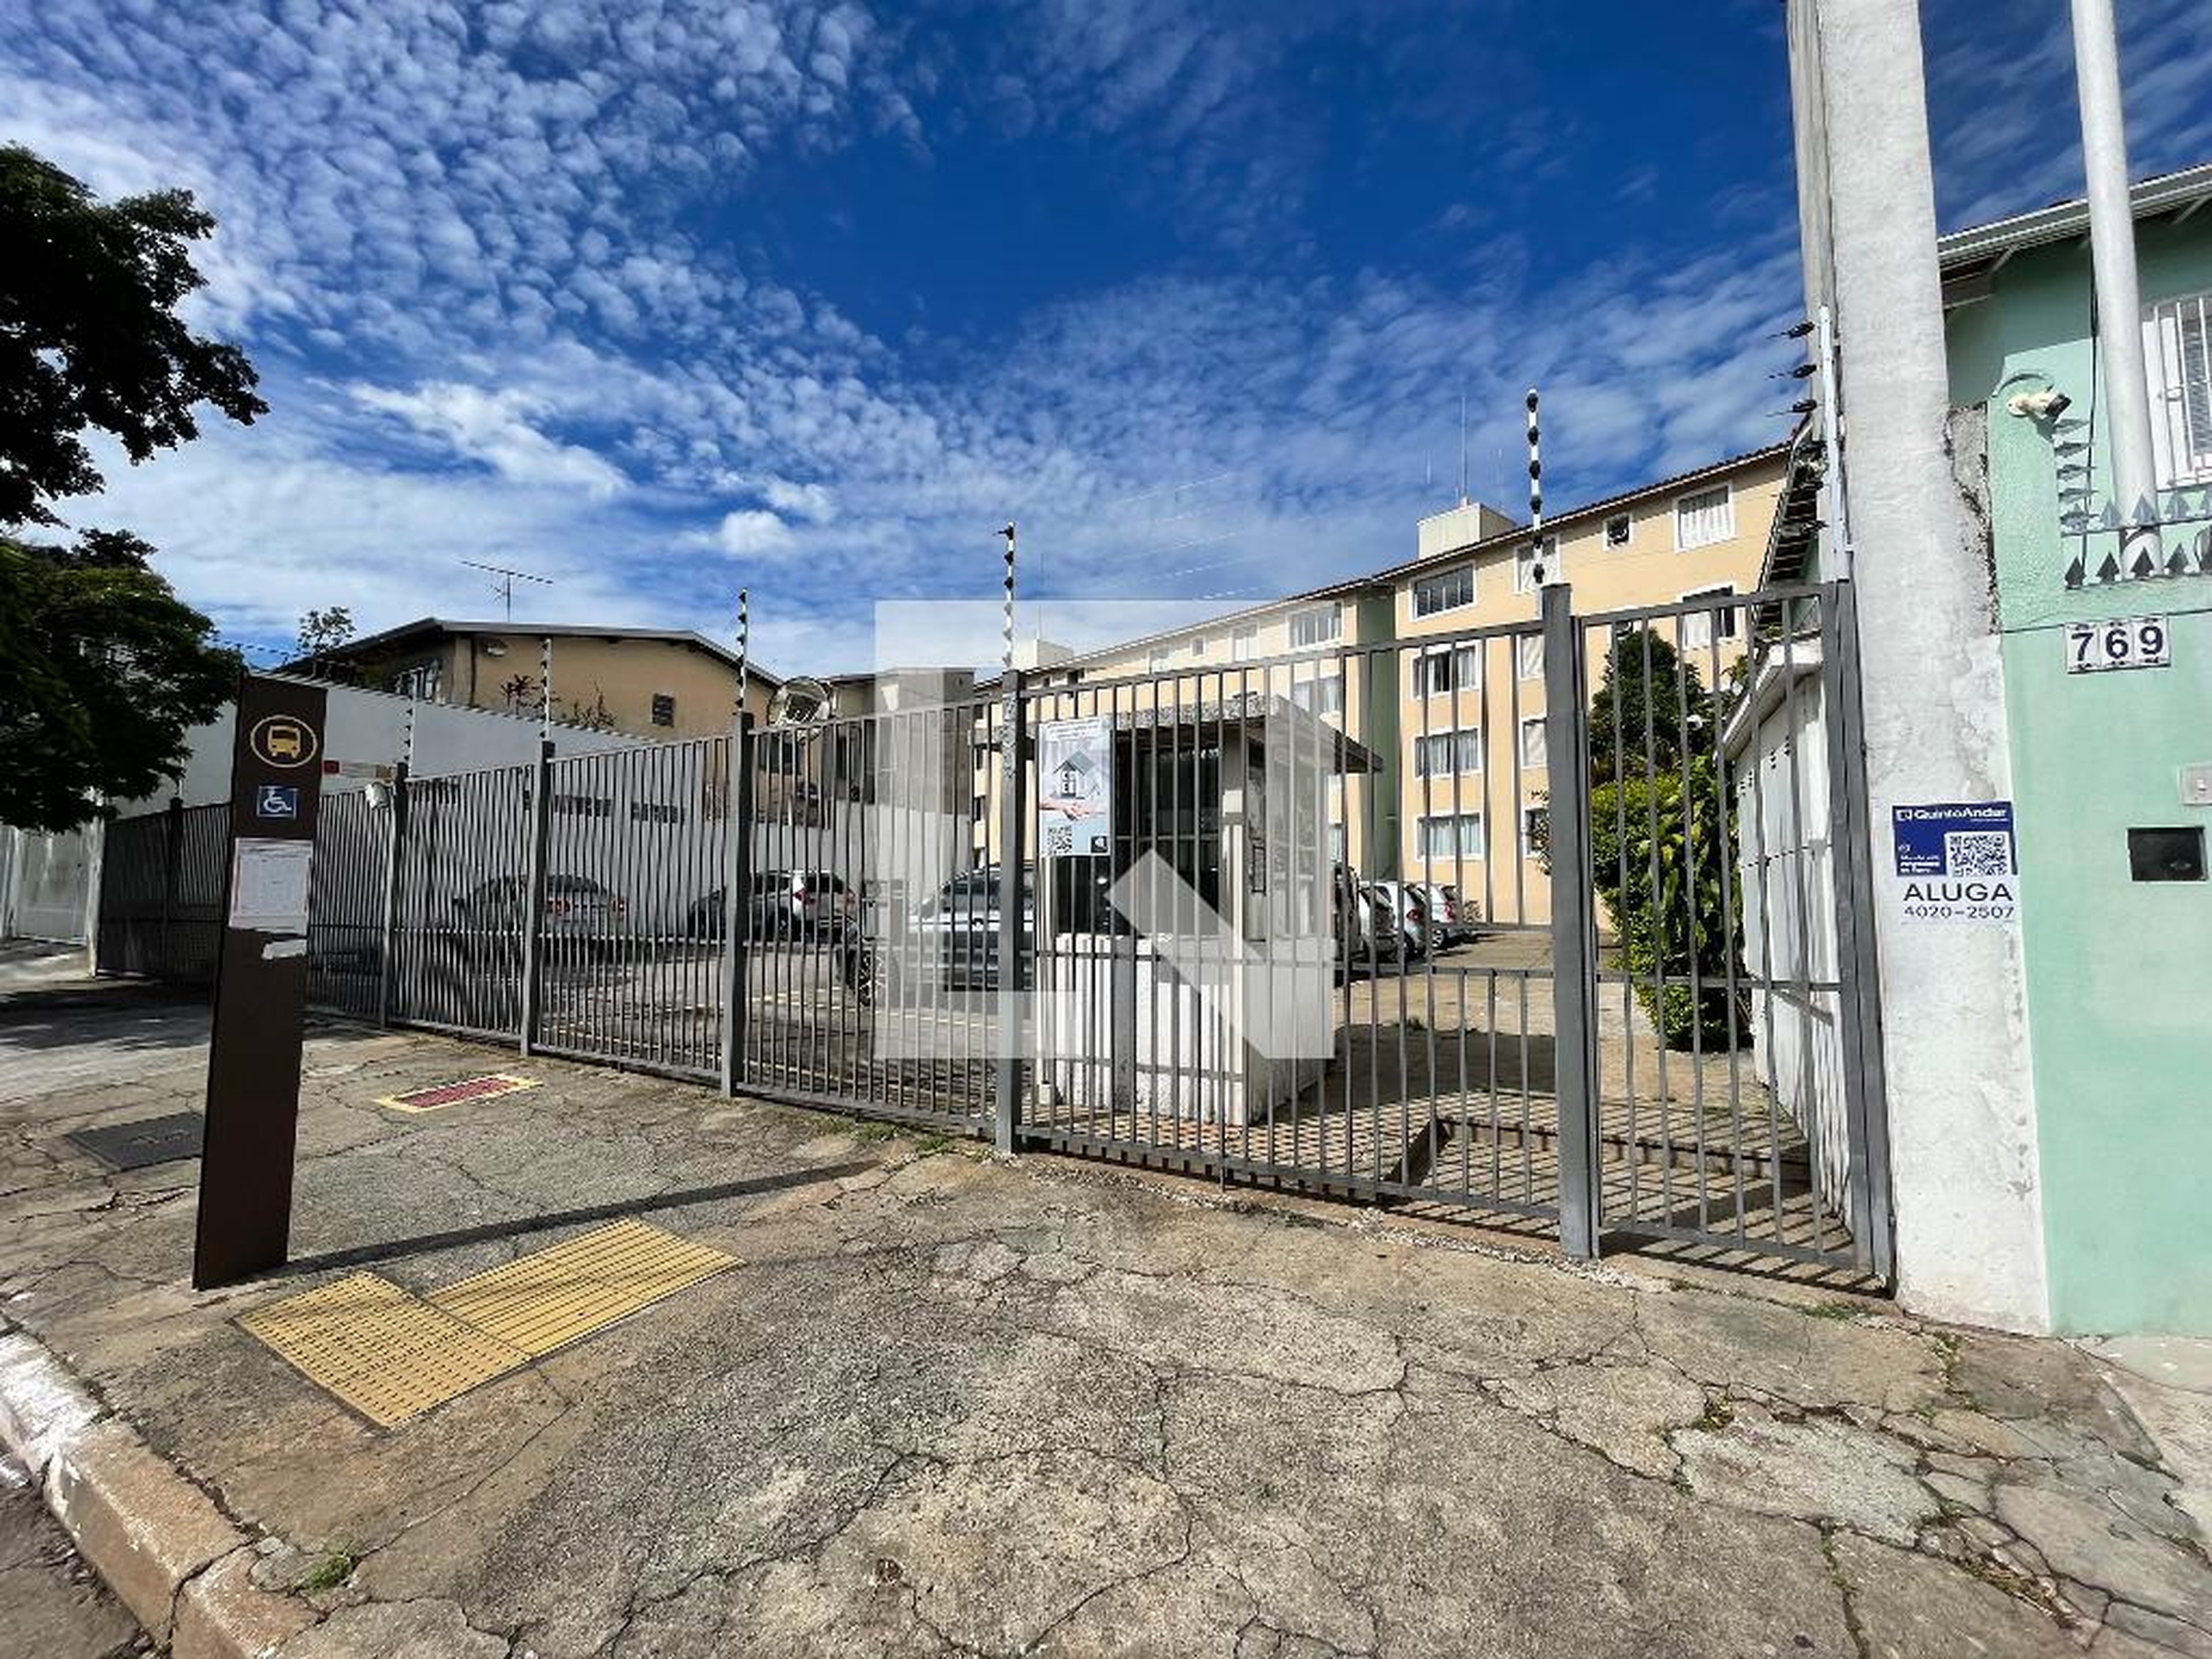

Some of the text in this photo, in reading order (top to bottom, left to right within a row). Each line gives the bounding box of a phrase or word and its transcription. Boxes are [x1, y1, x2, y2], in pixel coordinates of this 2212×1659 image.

[2071, 626, 2163, 661] 769
[1914, 808, 2006, 819] QuintoAndar
[1903, 883, 2013, 902] ALUGA
[1904, 906, 2014, 918] 4020-2507
